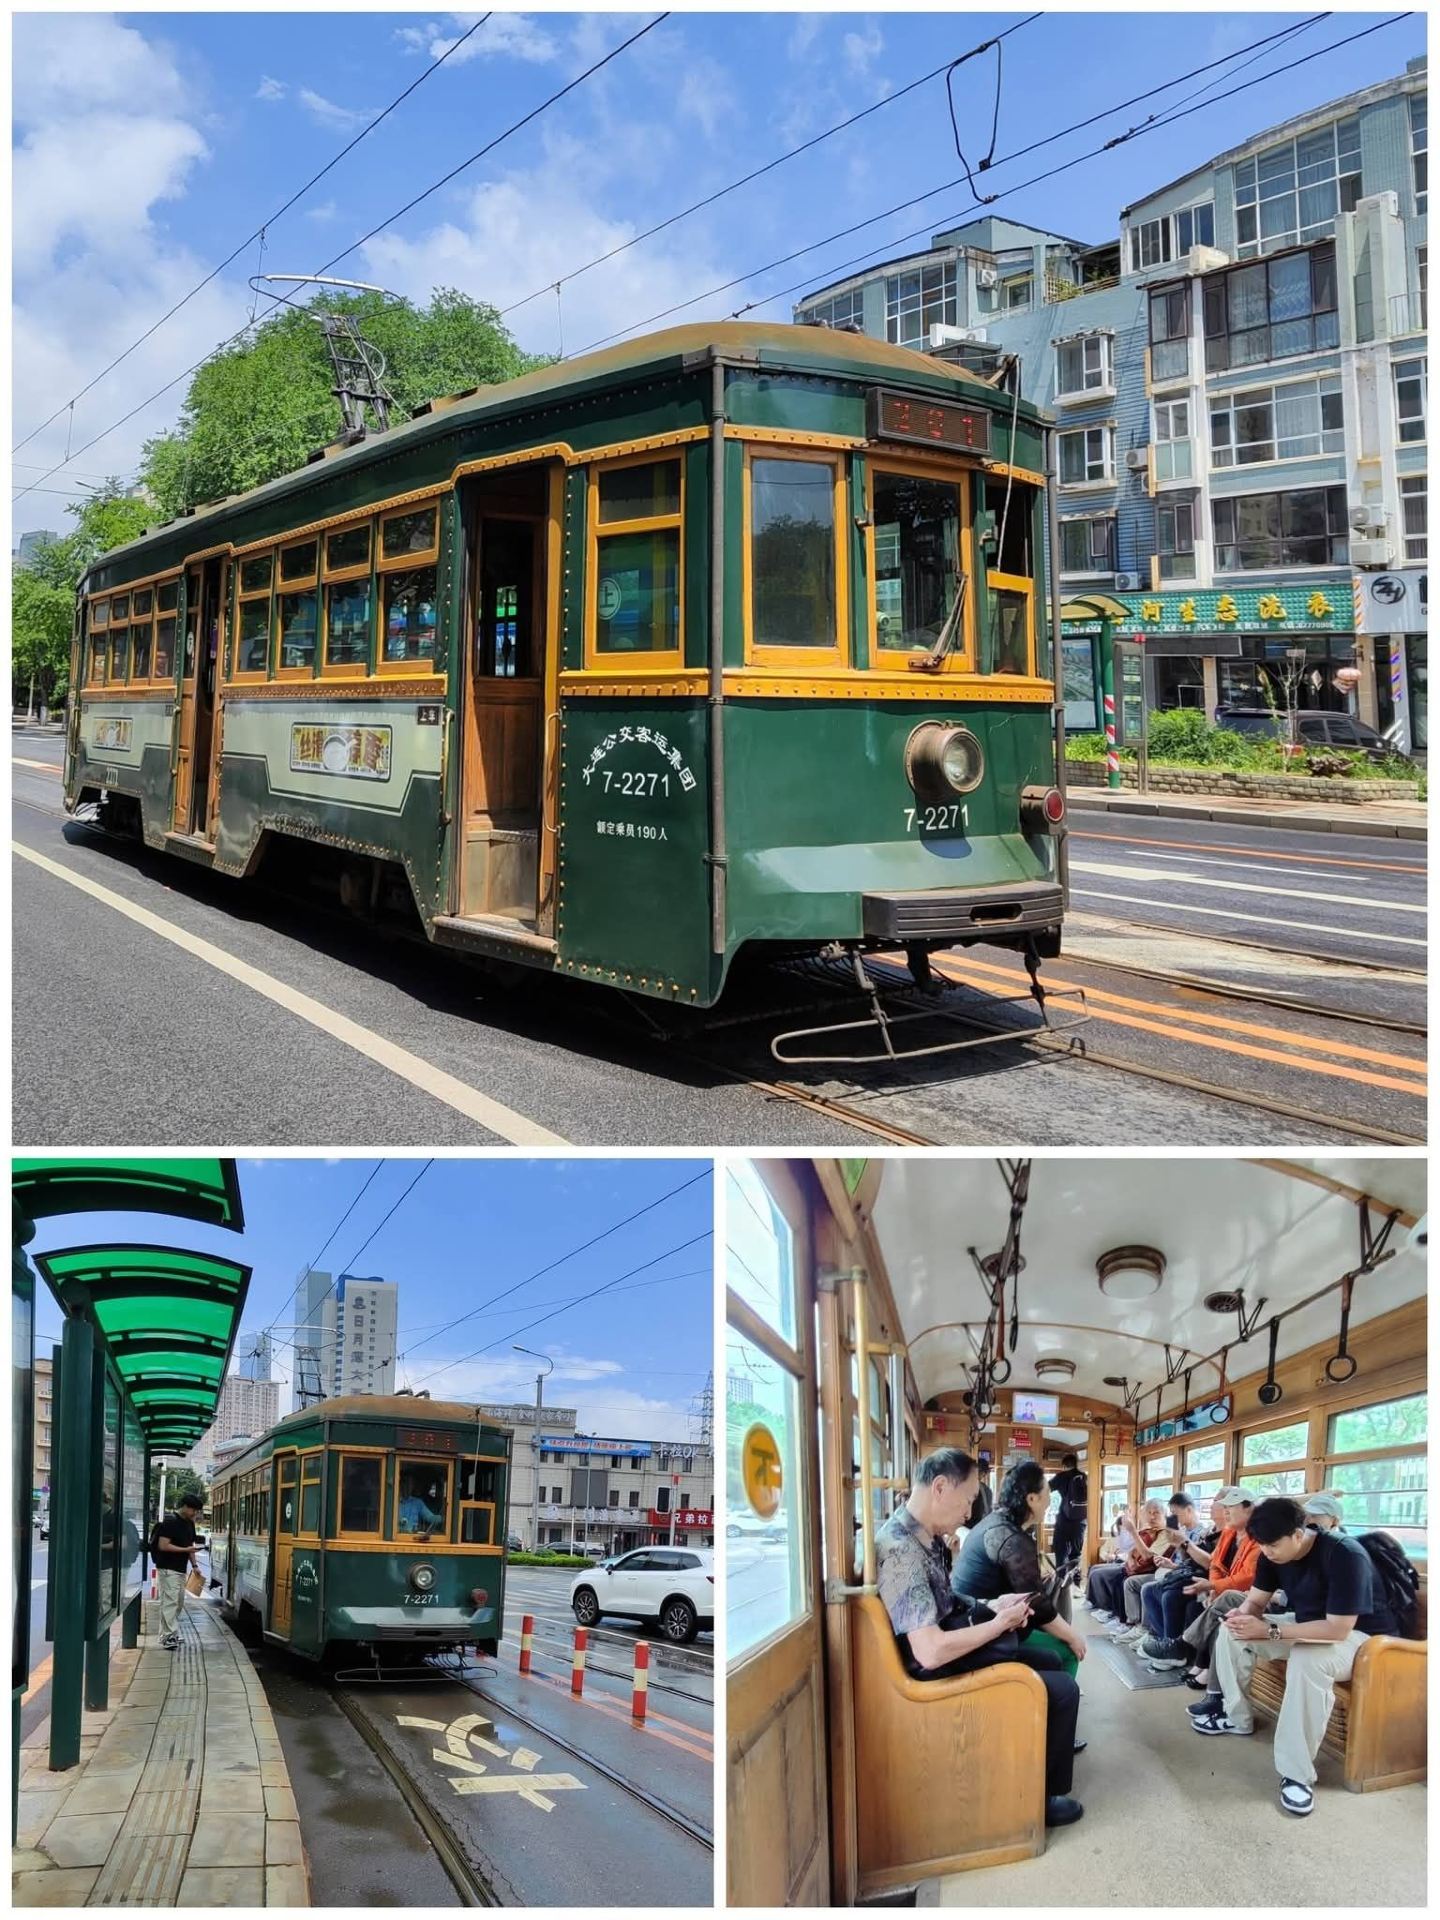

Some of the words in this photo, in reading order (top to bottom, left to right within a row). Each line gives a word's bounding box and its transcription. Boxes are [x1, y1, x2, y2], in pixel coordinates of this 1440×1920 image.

[1110, 592, 1335, 625] 河生态洗衣
[602, 771, 669, 797] 7-2271
[903, 804, 969, 832] 7-2271
[404, 1594, 439, 1604] 7-2271
